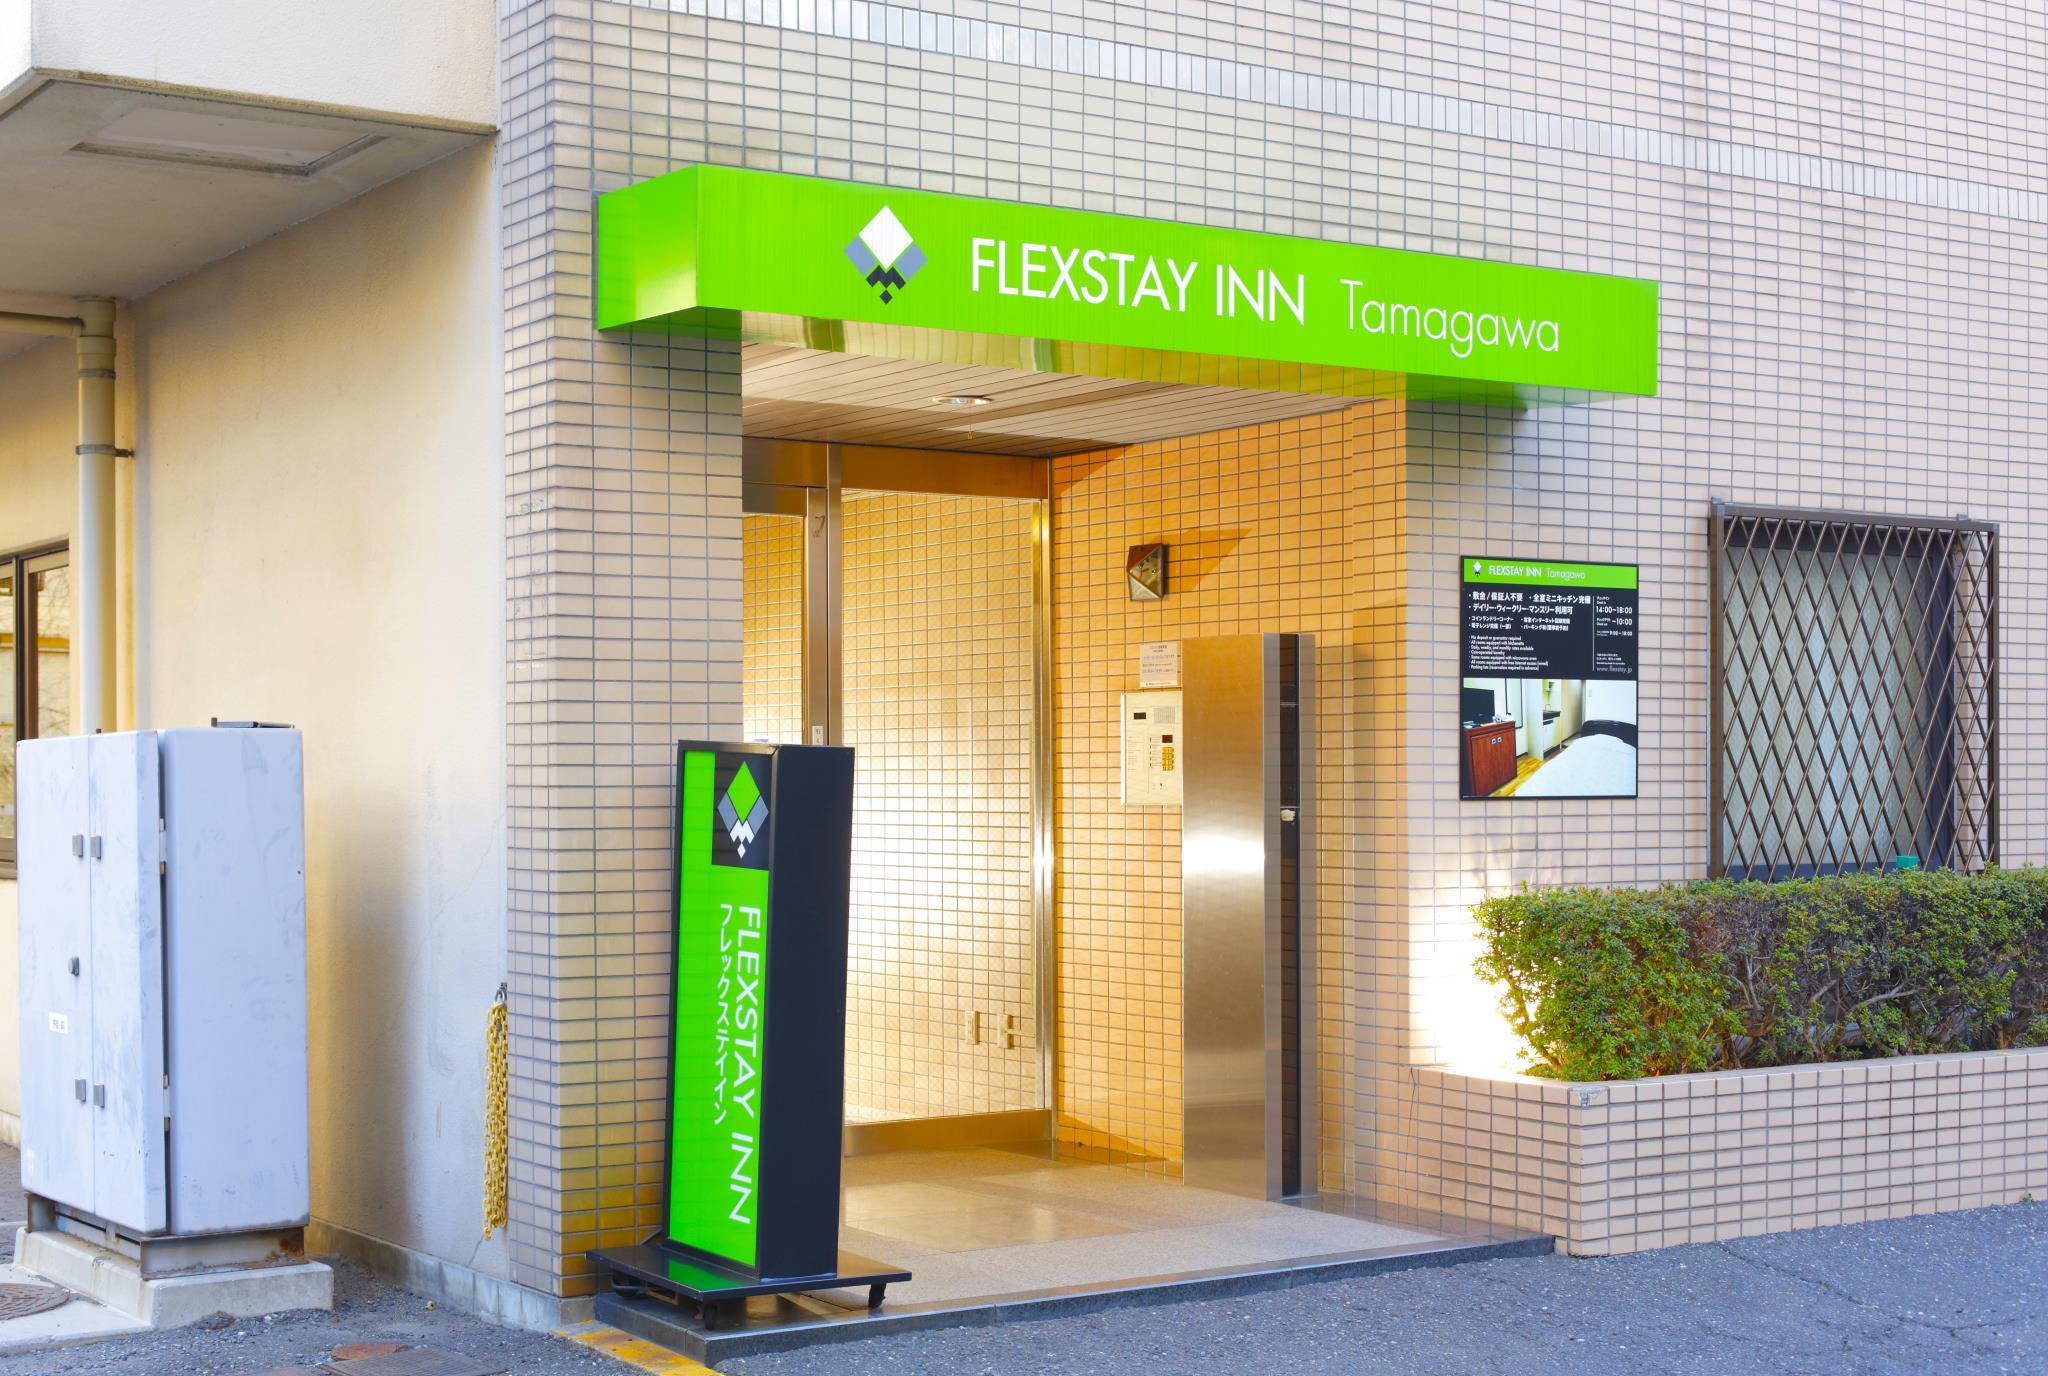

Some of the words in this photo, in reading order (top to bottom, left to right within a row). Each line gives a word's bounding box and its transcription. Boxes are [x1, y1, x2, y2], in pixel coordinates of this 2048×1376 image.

[970, 236, 1199, 313] FLEXSTAY
[1215, 263, 1305, 327] INN
[1339, 278, 1560, 359] Tamagawa
[1488, 565, 1524, 577] FLEXSTAY
[1525, 566, 1542, 577] INN
[1546, 567, 1585, 581] Tamagawa
[714, 904, 734, 1126] フレックステイイン
[731, 906, 761, 1119] FLEXSTAY
[727, 1132, 755, 1225] INN
